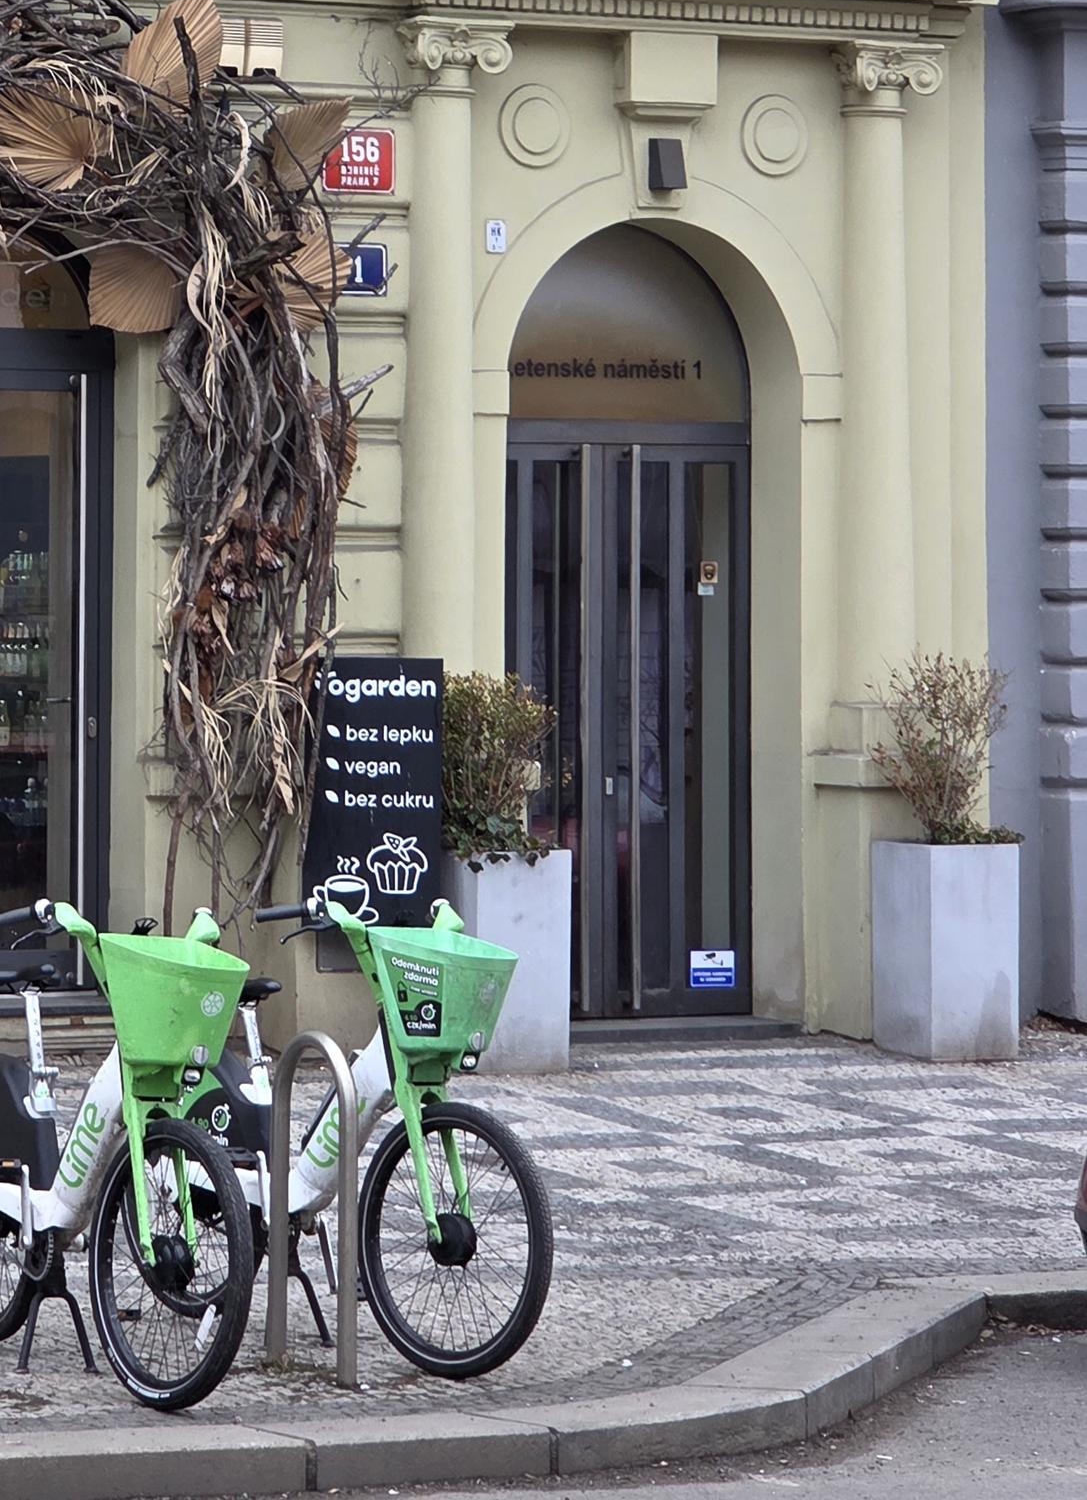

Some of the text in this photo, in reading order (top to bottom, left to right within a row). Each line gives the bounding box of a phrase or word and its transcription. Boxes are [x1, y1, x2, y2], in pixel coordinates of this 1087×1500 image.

[341, 136, 380, 163] 156
[341, 176, 379, 187] PRAHA 7
[354, 255, 363, 283] 1
[510, 358, 702, 380] etenské náměstí 1
[346, 724, 434, 746] bez lepku
[345, 760, 401, 778] vegan
[344, 790, 434, 809] bez cukru
[404, 971, 438, 986] zdarma
[59, 1102, 106, 1188] Lime
